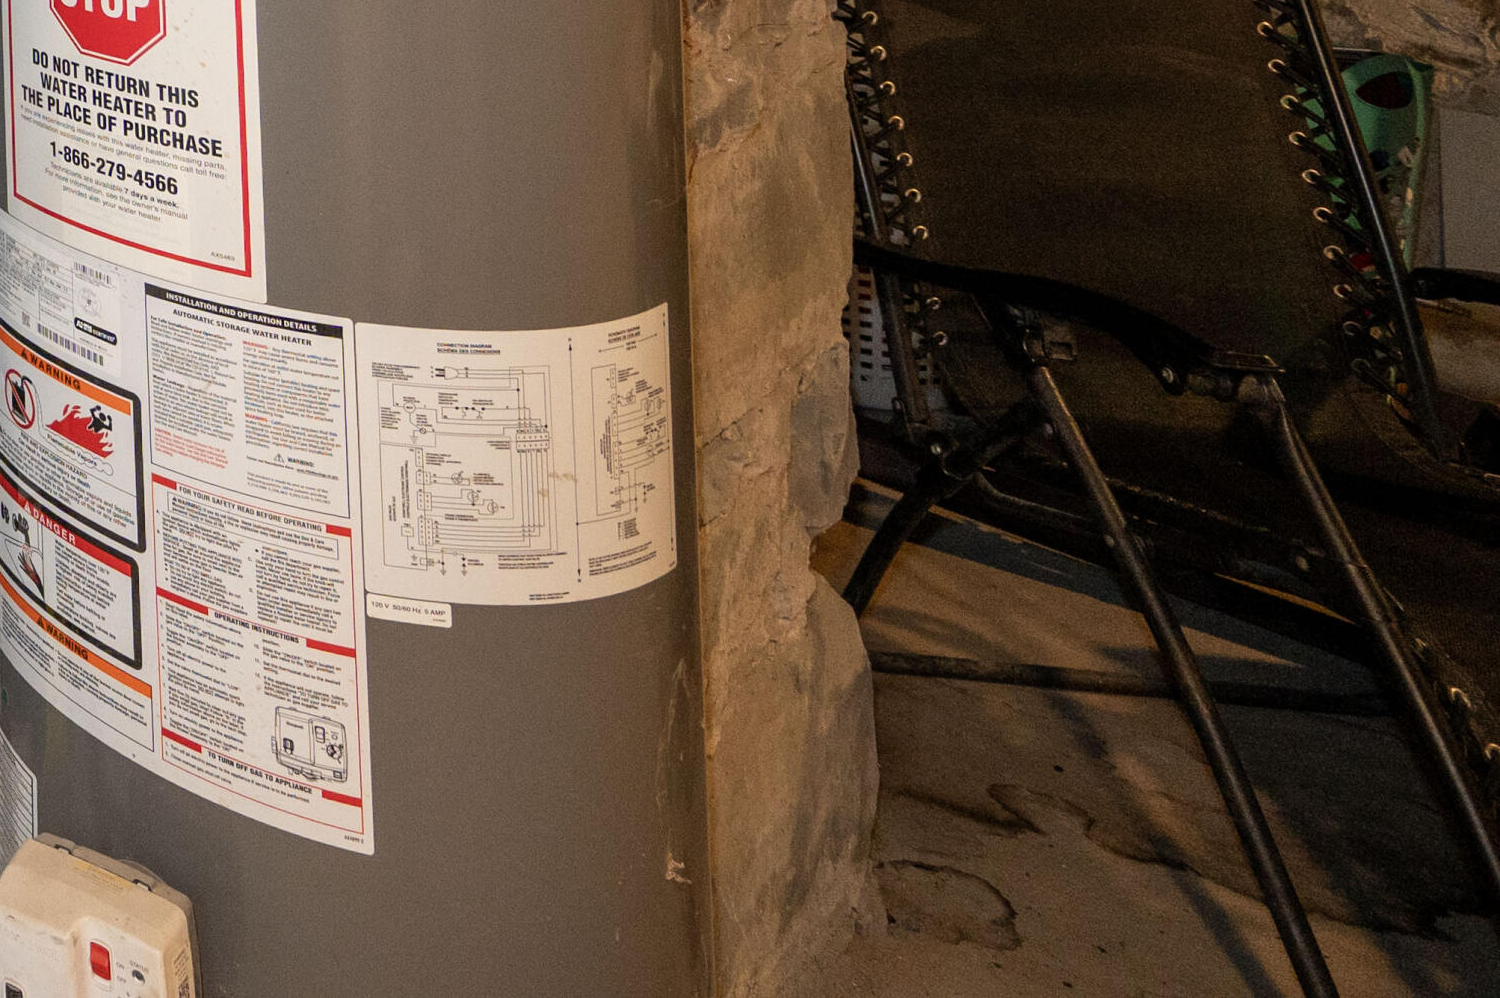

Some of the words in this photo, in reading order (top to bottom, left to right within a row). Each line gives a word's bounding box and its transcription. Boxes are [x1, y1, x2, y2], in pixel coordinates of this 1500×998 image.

[32, 48, 49, 69] DO
[52, 56, 80, 79] NOT
[84, 65, 150, 99] RETURN
[156, 83, 200, 108] THIS
[40, 71, 87, 103] WATER
[92, 89, 157, 122] HEATER
[162, 107, 187, 128] TO
[21, 84, 44, 109] THE
[47, 96, 92, 126] PLACE
[96, 113, 118, 132] OF
[123, 119, 223, 158] PURCHASE
[50, 141, 178, 196] 1-866-279-4566
[96, 132, 111, 141] with
[125, 141, 144, 152] water
[172, 152, 202, 167] missing
[116, 146, 142, 162] general
[142, 153, 178, 171] questions
[179, 162, 194, 173] call
[195, 166, 208, 176] toll
[88, 192, 101, 204] with
[102, 200, 117, 211] your
[117, 203, 137, 216] water
[105, 190, 118, 200] see
[119, 193, 131, 204] the
[160, 206, 189, 221] manual
[124, 187, 129, 195] 7
[130, 189, 149, 202] days
[156, 196, 180, 209] week.
[165, 291, 218, 313] INSTALLATION
[218, 305, 236, 317] AND
[237, 309, 283, 327] OPERATION
[283, 319, 317, 333] DETAILS
[172, 308, 215, 327] AUTOMATIC
[216, 320, 251, 334] STORAGE
[251, 329, 280, 341] WATER
[280, 334, 313, 347] HEATER
[31, 351, 81, 391] WARNING
[32, 509, 76, 546] DANGER
[179, 485, 192, 497] FOR
[192, 490, 211, 504] YOUR
[211, 496, 236, 511] SAFETY
[236, 504, 255, 516] READ
[256, 510, 282, 523] BEFORE
[283, 517, 323, 533] OPERATING
[46, 622, 89, 661] WARNING
[213, 611, 250, 630] OPERATING
[251, 624, 300, 644] INSTRUCTIONS
[207, 751, 217, 760] TO
[217, 755, 235, 768] TURN
[236, 762, 248, 773] OFF
[249, 767, 264, 779] GAS
[264, 773, 274, 782] TO
[275, 777, 313, 795] APPLIANCE
